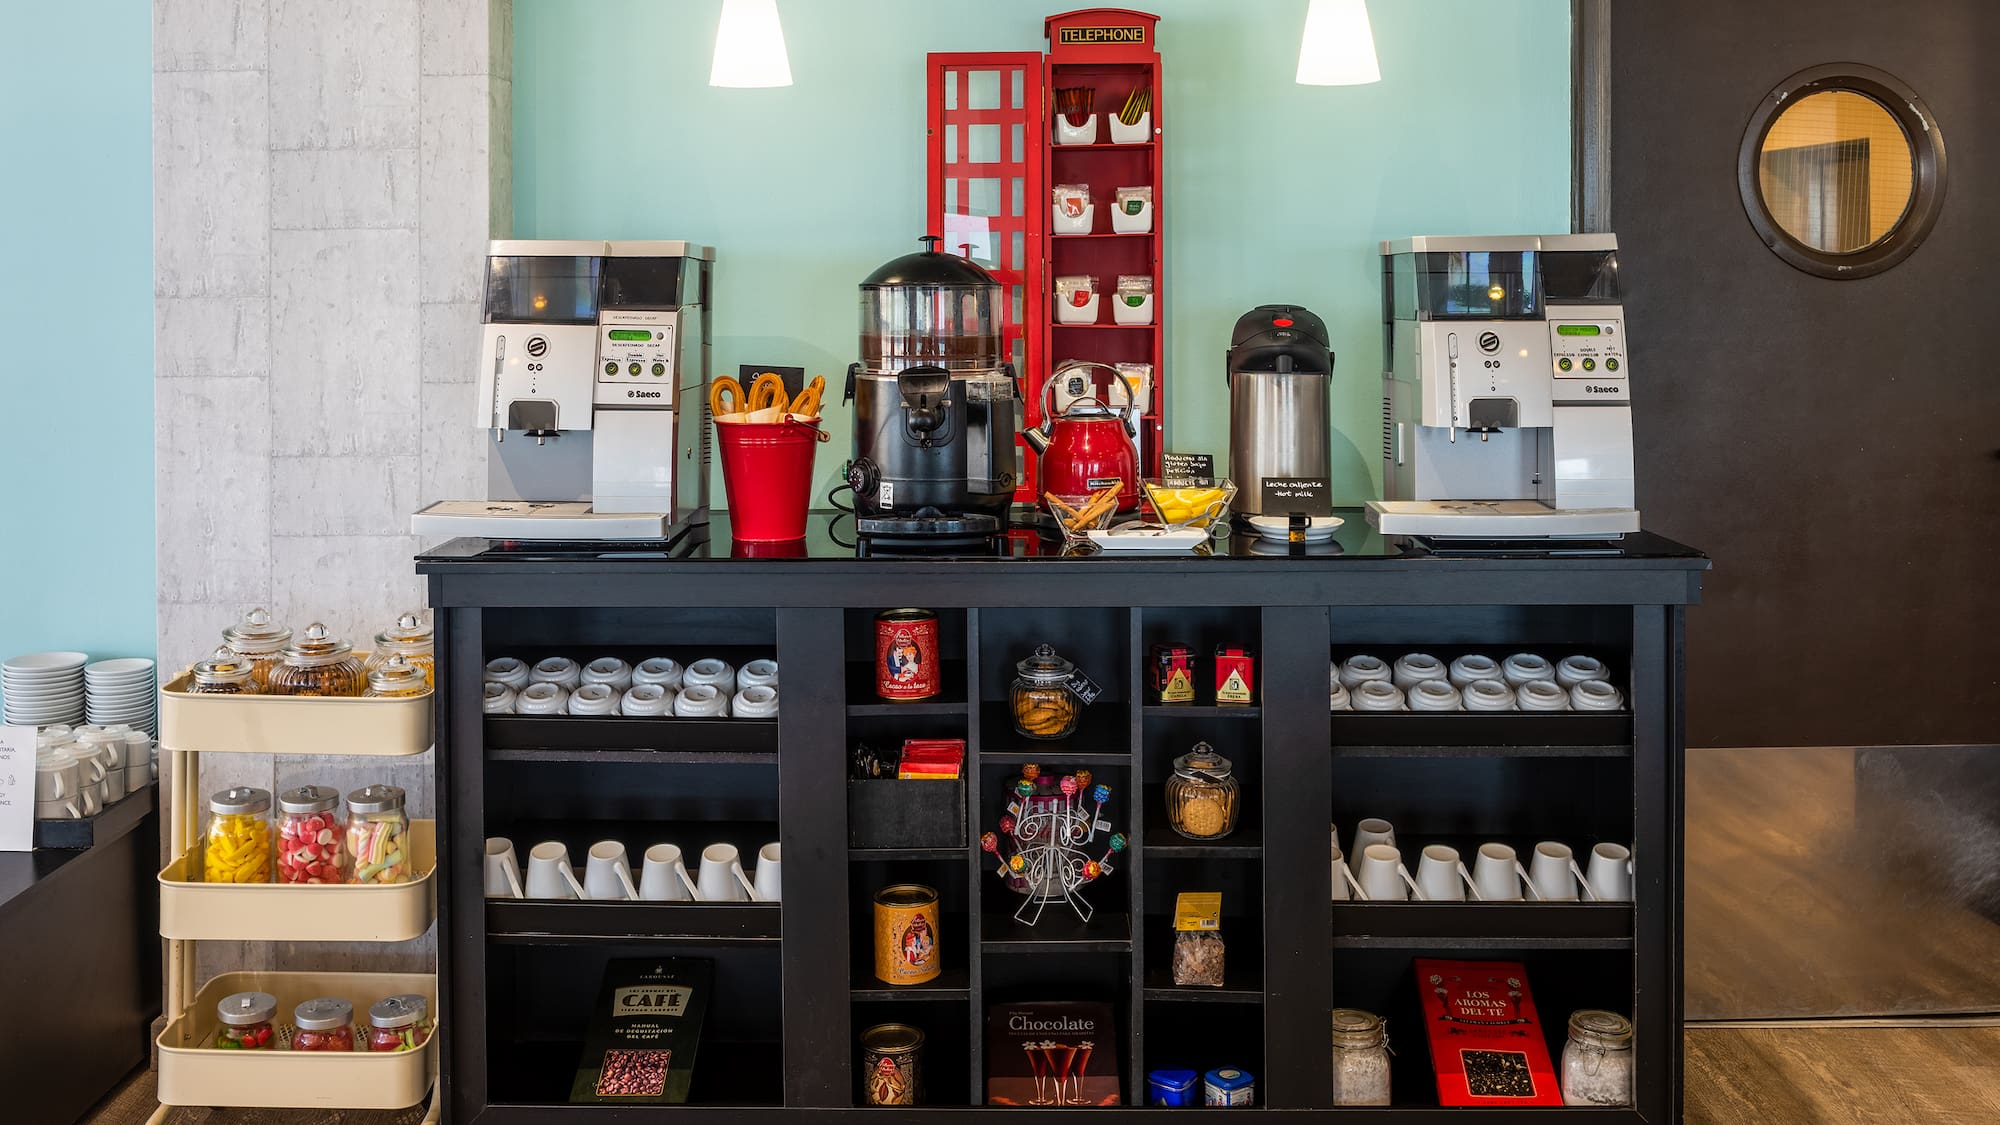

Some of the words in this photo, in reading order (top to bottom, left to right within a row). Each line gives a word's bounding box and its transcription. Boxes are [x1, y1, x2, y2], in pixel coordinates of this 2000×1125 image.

[1061, 28, 1142, 41] TELEPHONE
[636, 390, 661, 398] Saeco
[622, 993, 682, 1007] CAFÉ
[1455, 998, 1507, 1007] AROMAS
[1461, 1007, 1485, 1016] DEL
[1008, 1015, 1095, 1031] Chocolate
